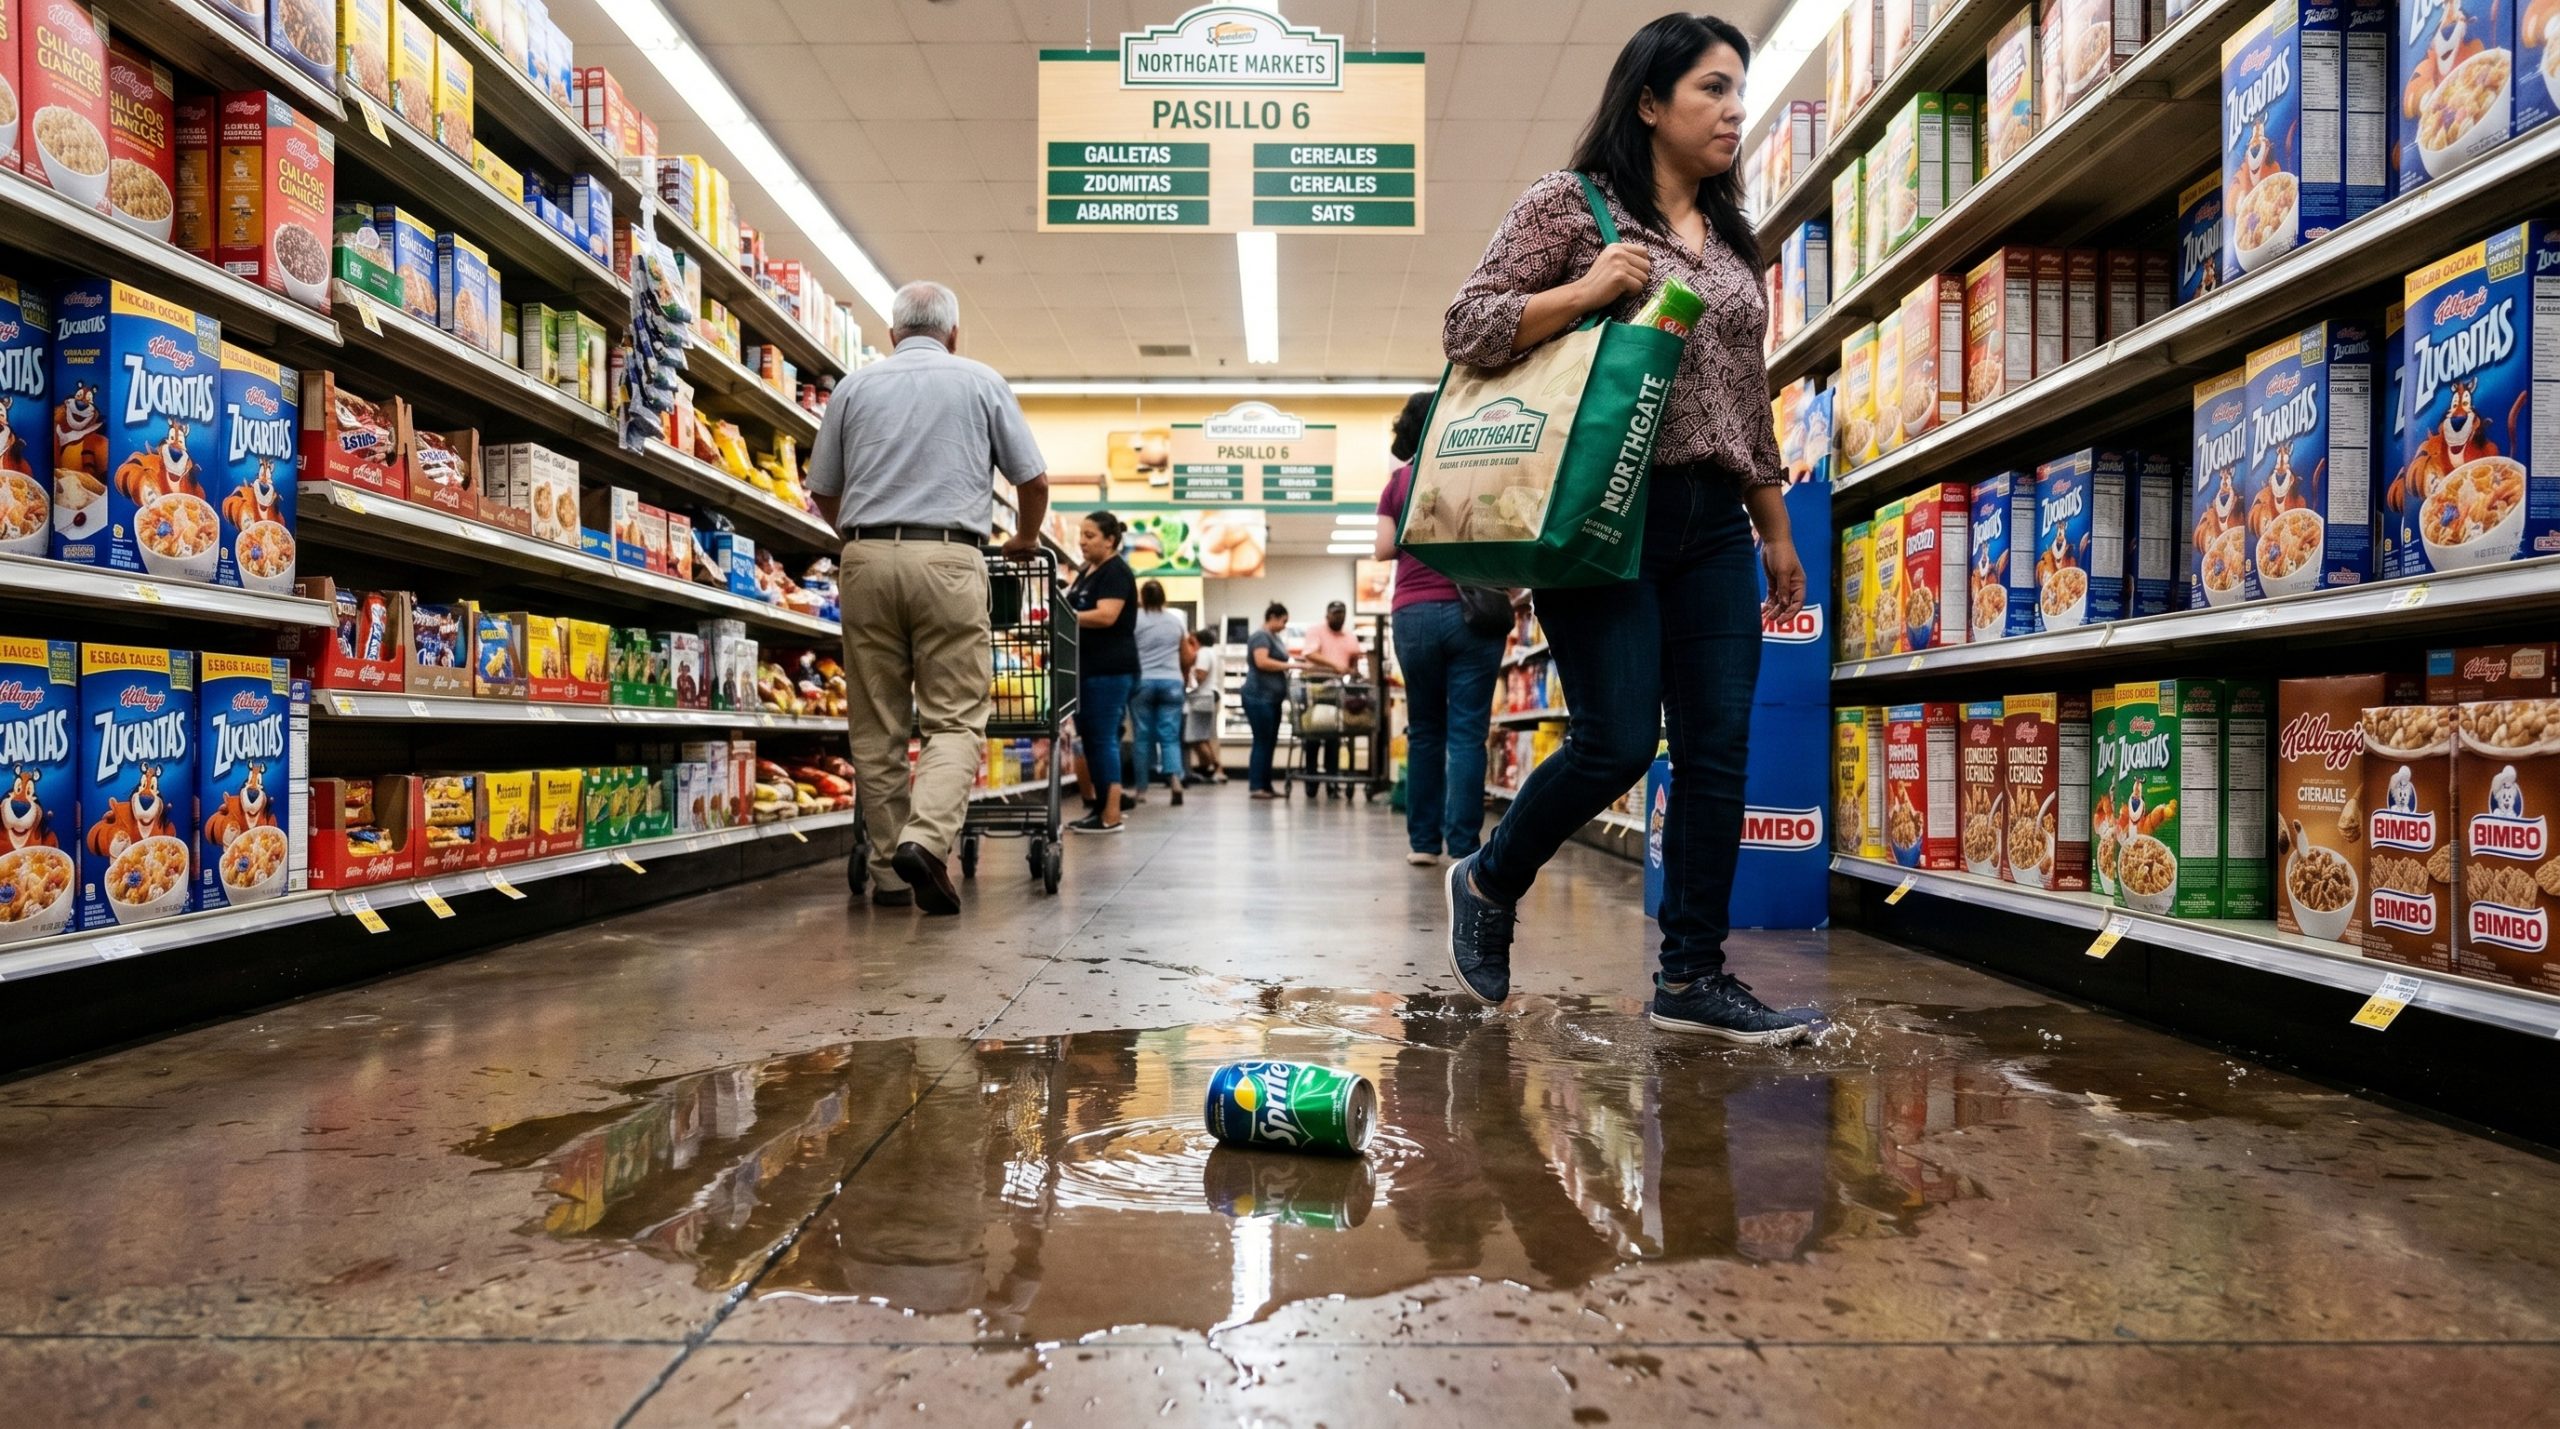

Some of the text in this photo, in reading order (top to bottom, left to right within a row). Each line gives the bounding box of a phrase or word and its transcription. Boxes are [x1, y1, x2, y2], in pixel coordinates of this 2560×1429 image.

[1137, 53, 1326, 74] NORTHGATE MARKETS
[2226, 45, 2290, 152] ZUCARITAS
[1152, 99, 1311, 130] PASILLO 6
[1084, 145, 1172, 165] GALLETAS
[1290, 146, 1377, 165] CEREALES
[1083, 173, 1172, 193] ZDOMITAS
[1290, 174, 1377, 194] CEREALES
[1076, 202, 1179, 222] ABARROTES
[1311, 204, 1356, 222] SATS
[57, 314, 107, 341] ZUCARITAS
[2413, 297, 2514, 415] ZUCARITAS
[124, 353, 215, 425] ZUCARITAS
[227, 403, 293, 464] ZUCARITAS
[1446, 423, 1536, 449] NORTHGATE
[2252, 381, 2318, 472] ZUCARITAS
[1217, 445, 1290, 460] PASILLO 6
[1600, 372, 1666, 514] NORTHGATE
[2196, 419, 2246, 493] ZUCARITA
[94, 709, 187, 783] ZUCARITAS
[212, 712, 283, 780] ZUCARITAS
[2281, 711, 2365, 771] Kellogg's
[2118, 732, 2171, 782] ZUCARITAS
[2373, 817, 2433, 844] BIMBO
[2473, 823, 2543, 852] BIMBO
[2373, 901, 2434, 928] BIMBO
[2473, 911, 2543, 943] BIMBO
[1258, 1062, 1302, 1147] Sprite
